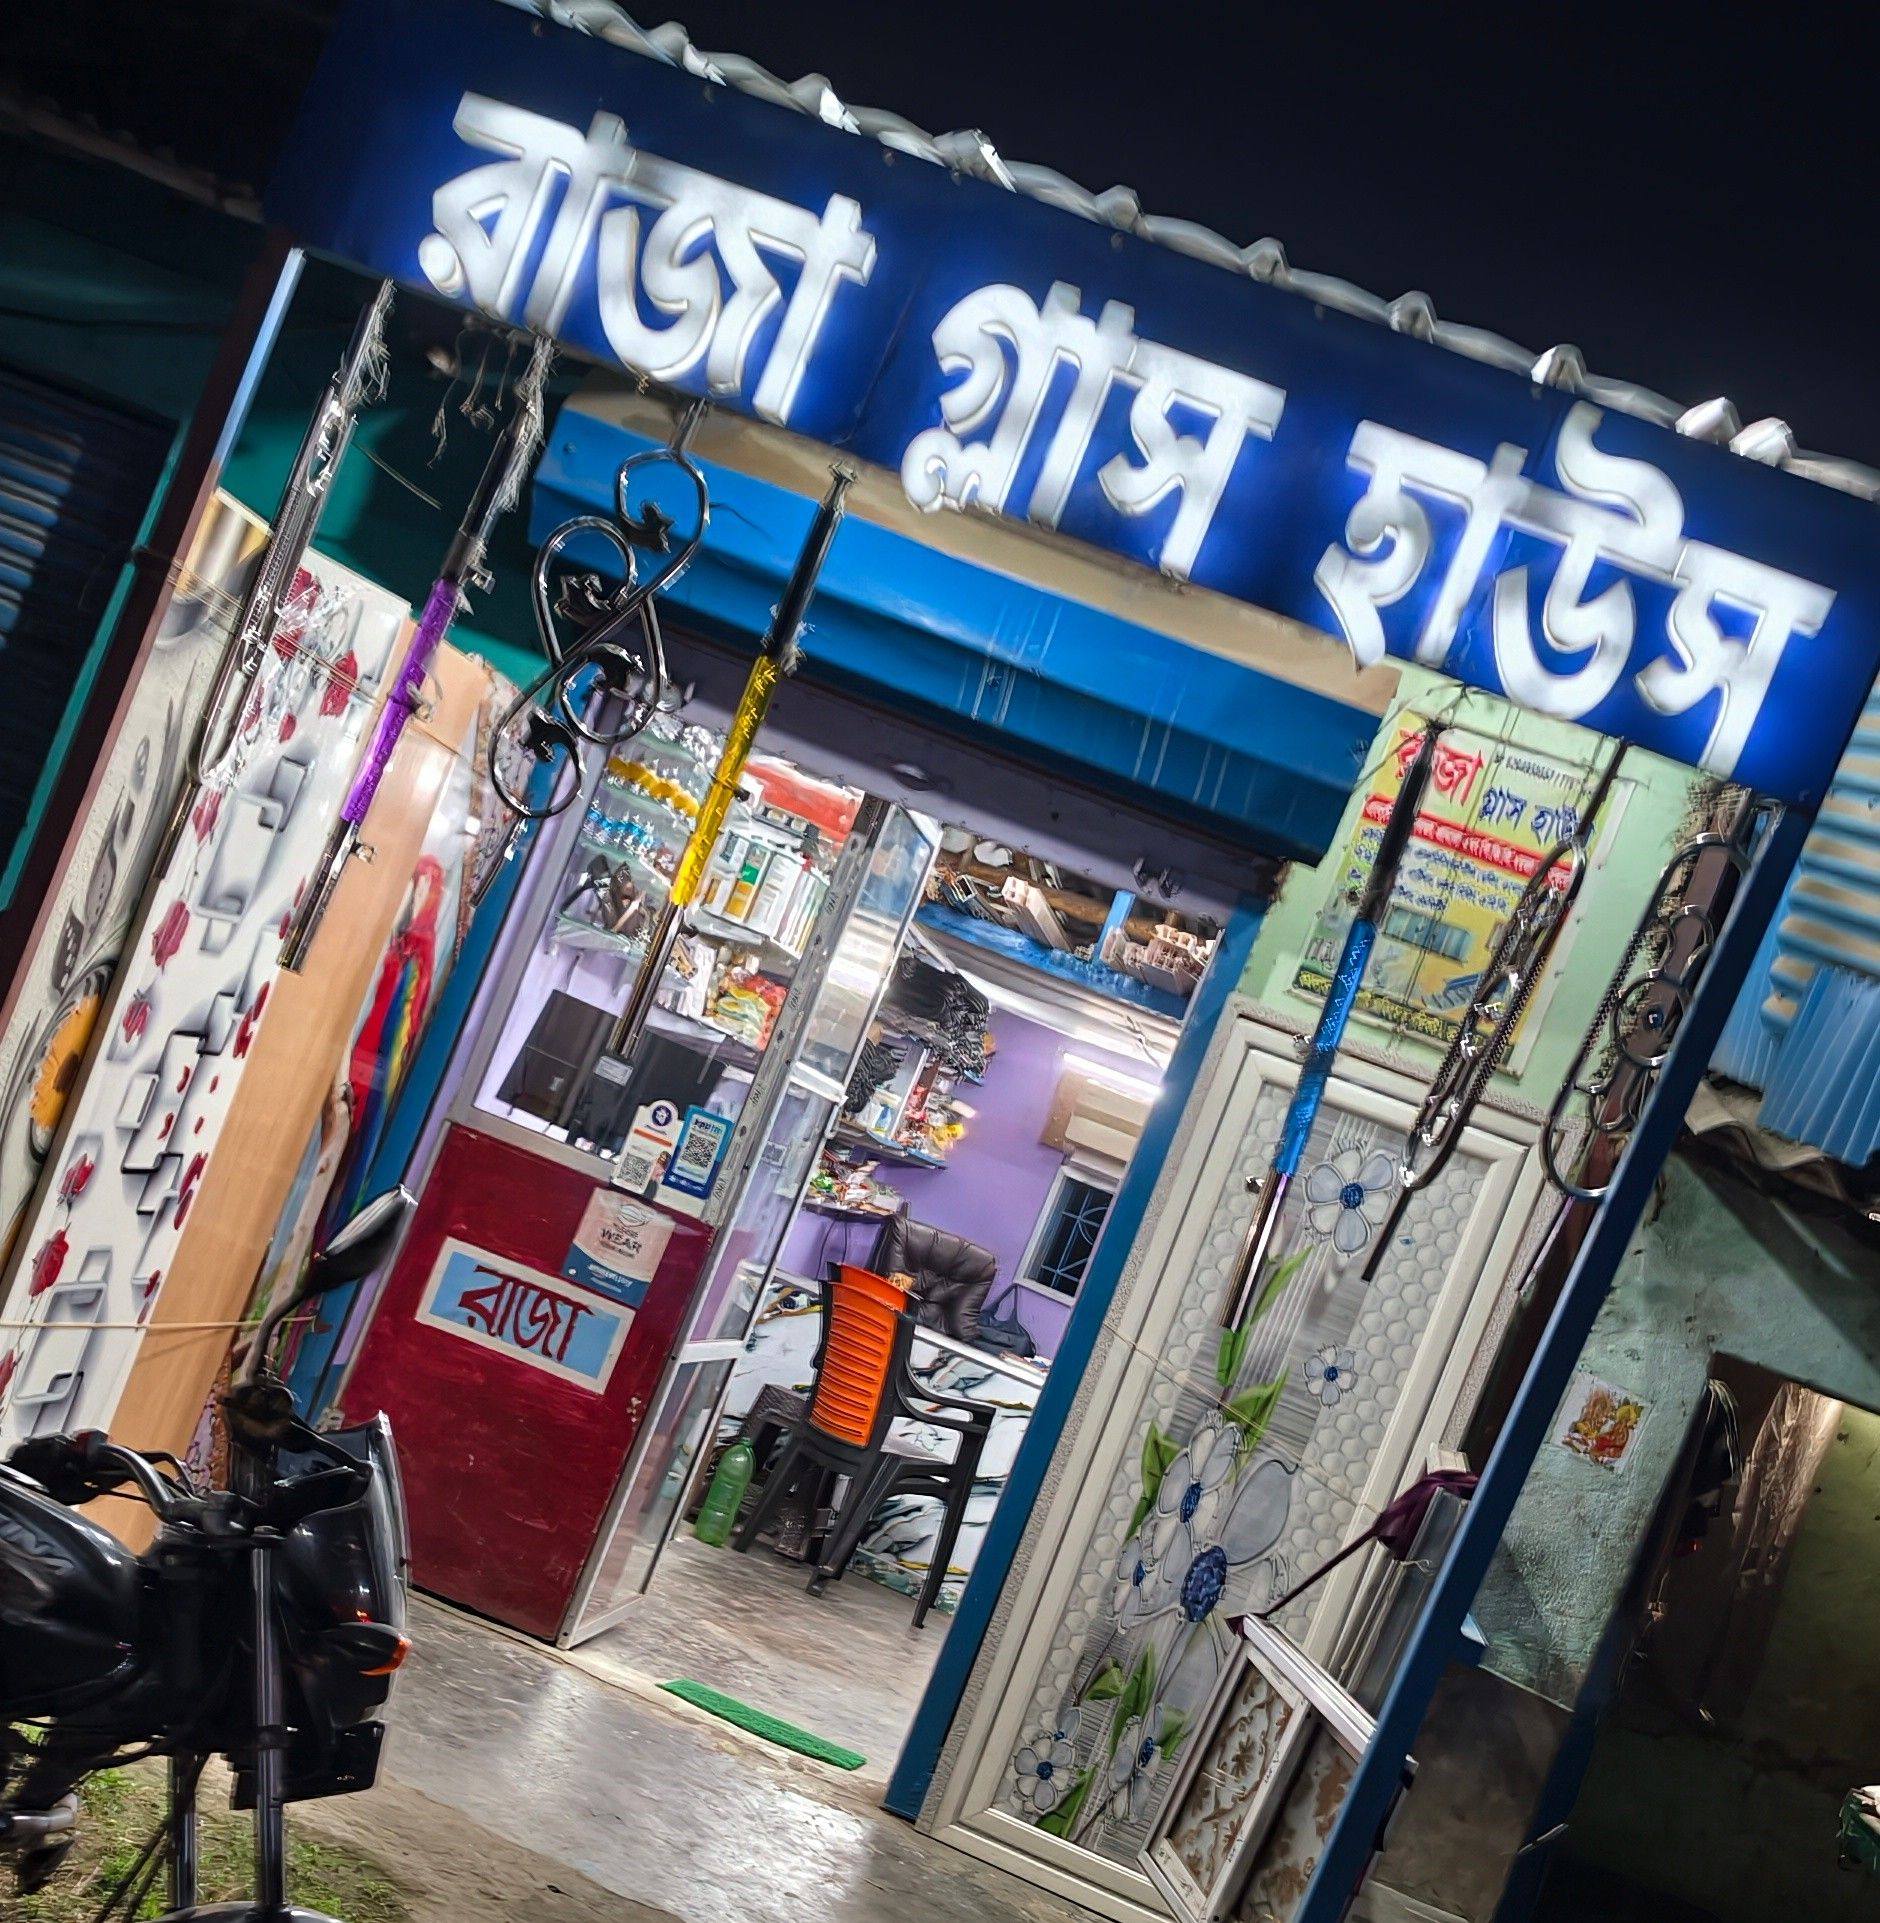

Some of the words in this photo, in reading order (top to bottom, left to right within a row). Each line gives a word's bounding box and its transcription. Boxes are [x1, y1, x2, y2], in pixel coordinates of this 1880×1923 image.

[418, 92, 877, 424] রাজা
[902, 281, 1286, 580] গ্লাস
[1314, 403, 1837, 774] হাউস
[1396, 729, 1484, 807] রজা
[458, 1265, 597, 1361] রাজা
